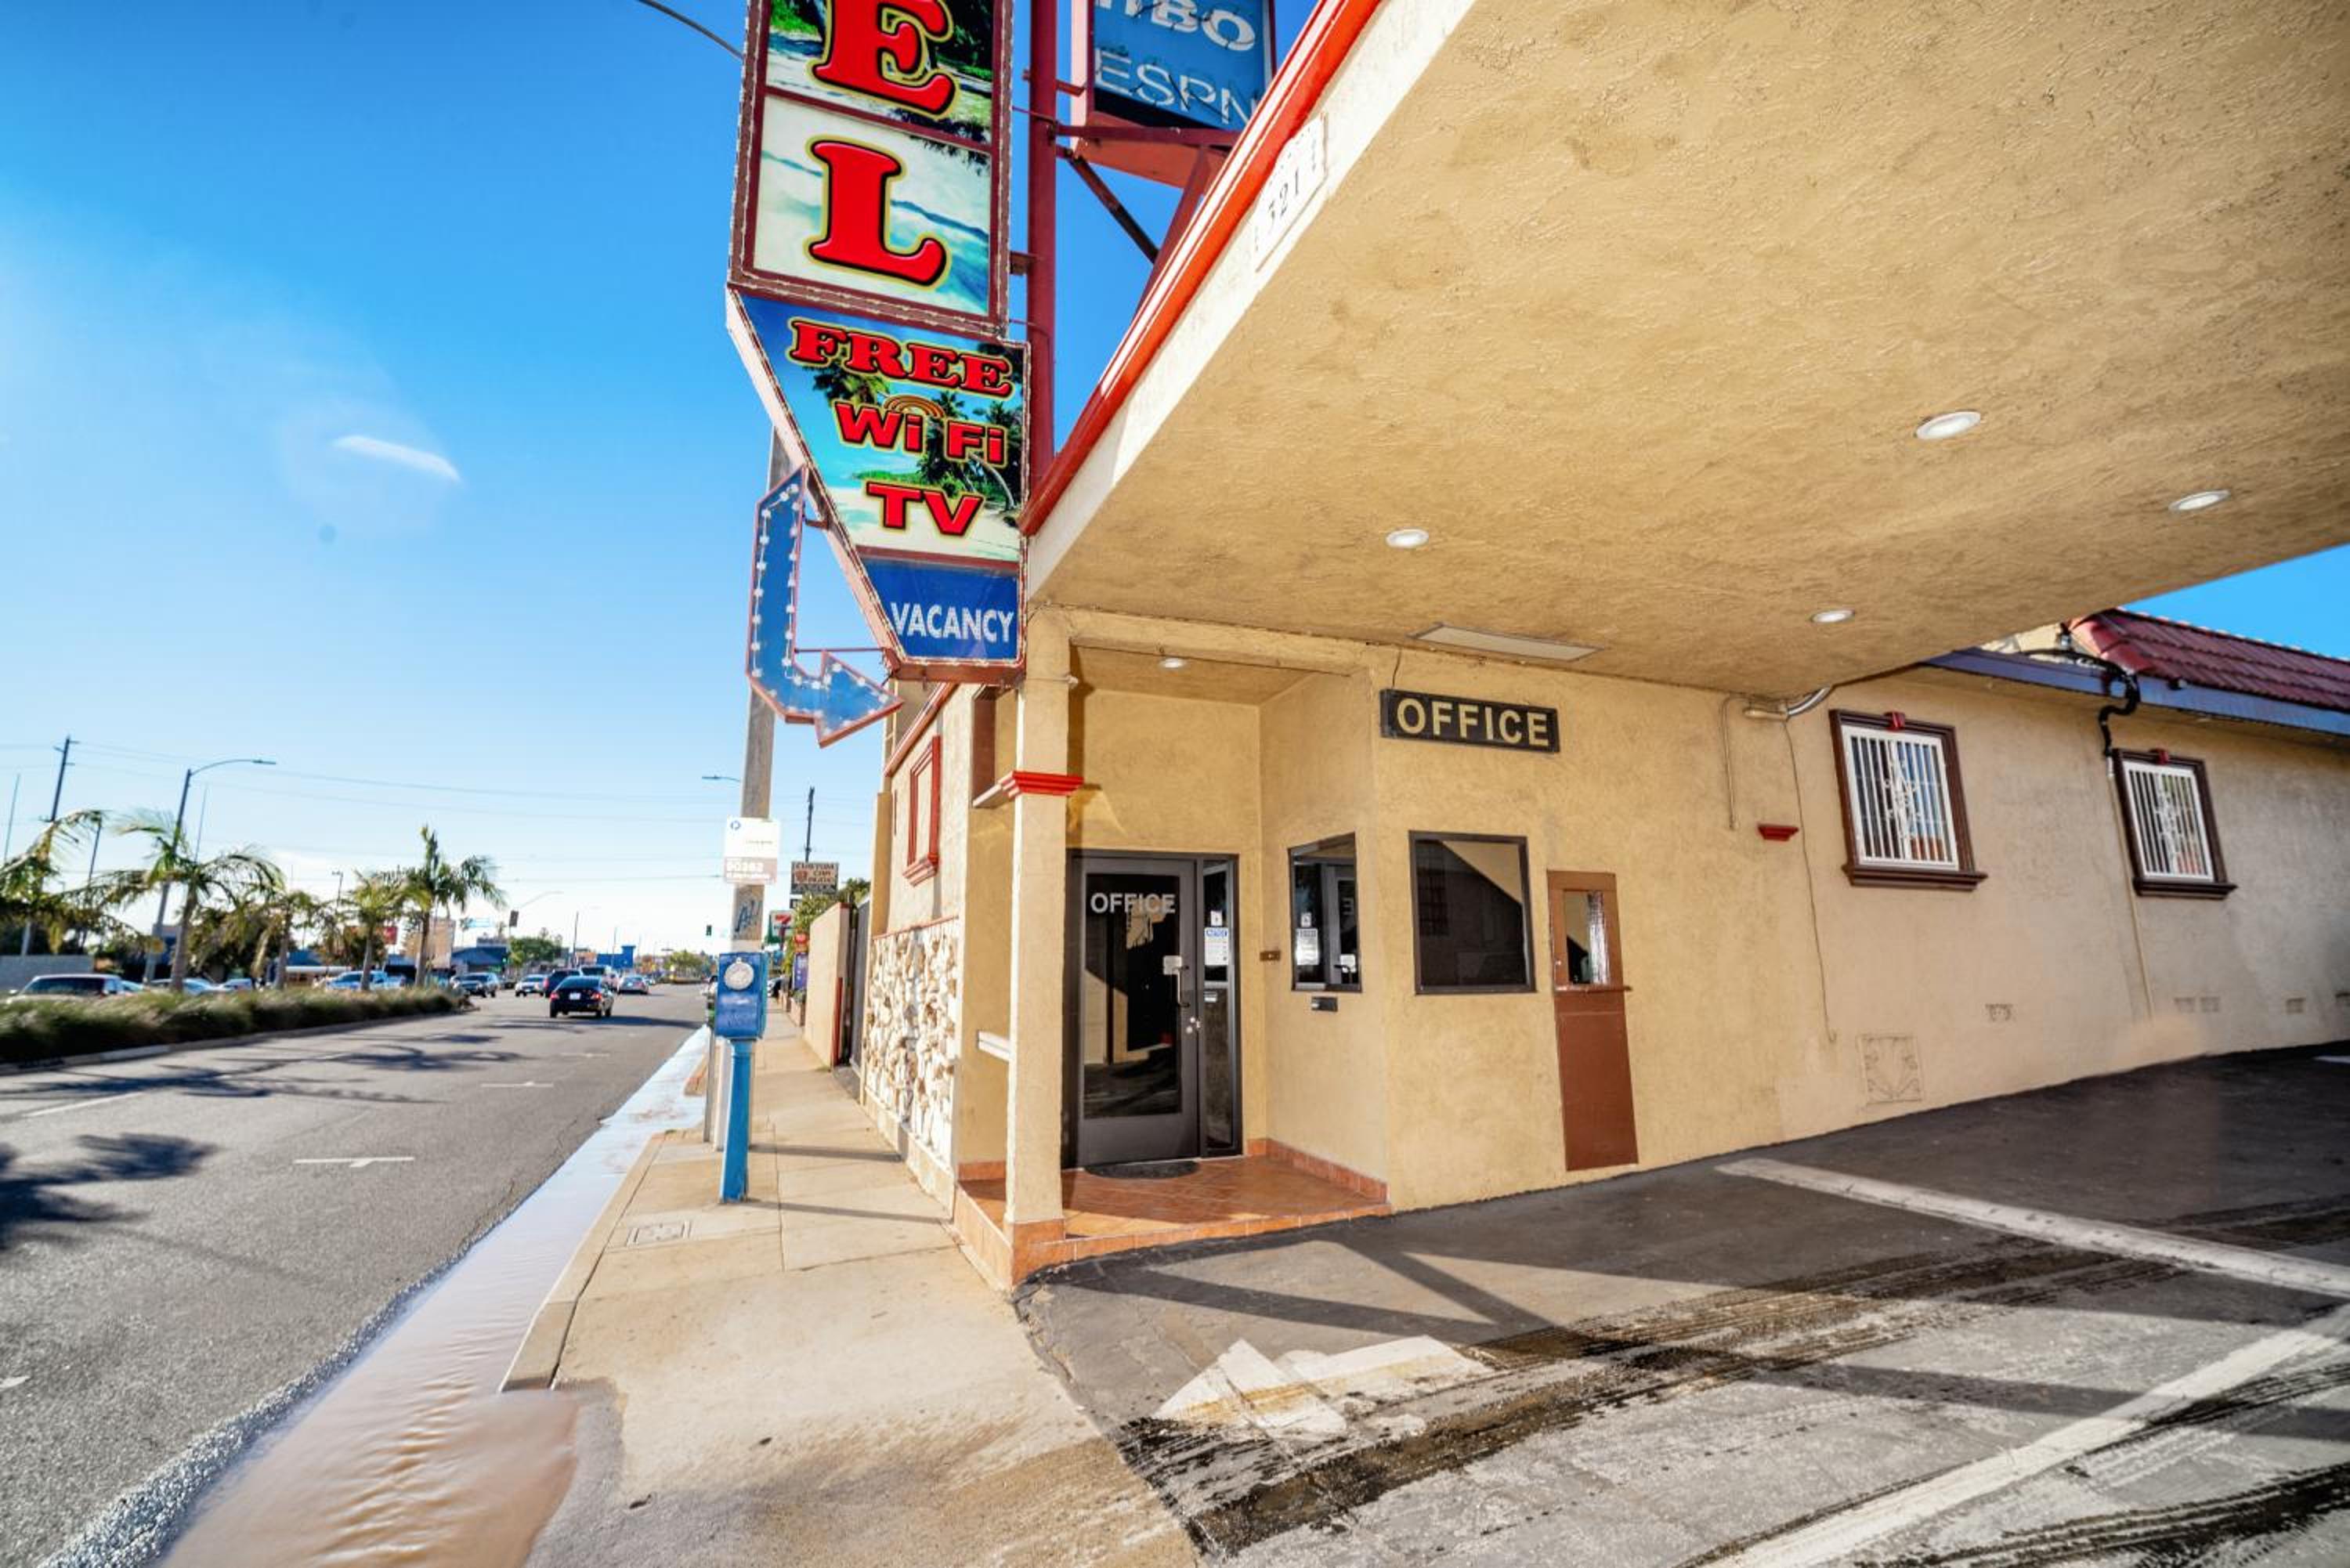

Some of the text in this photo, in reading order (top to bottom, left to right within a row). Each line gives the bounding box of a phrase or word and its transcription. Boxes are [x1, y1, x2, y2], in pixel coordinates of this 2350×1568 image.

[1094, 48, 1259, 125] ESPN
[786, 316, 1015, 396] FREE
[865, 479, 985, 538] TV
[889, 601, 1016, 644] VACANCY
[1397, 697, 1550, 747] OFFICE
[1090, 891, 1177, 915] OFFICE
